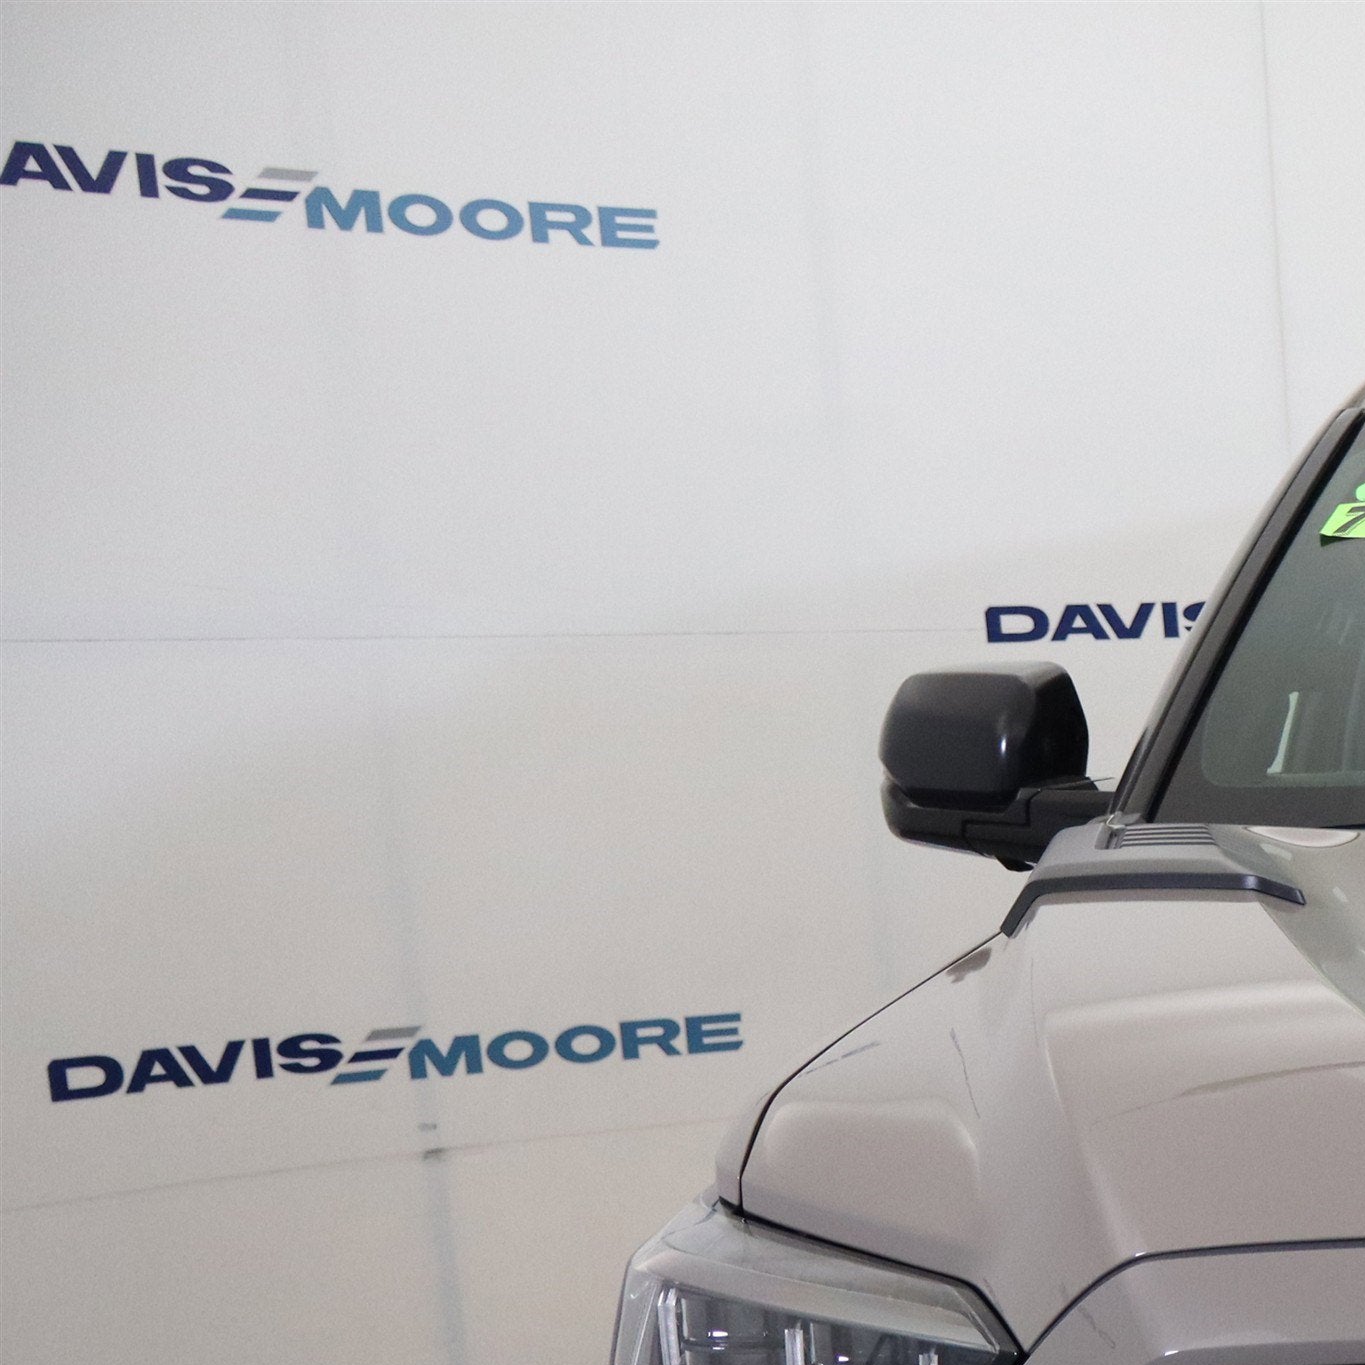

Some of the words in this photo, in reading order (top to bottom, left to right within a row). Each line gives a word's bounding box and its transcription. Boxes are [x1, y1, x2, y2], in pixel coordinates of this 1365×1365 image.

[0, 140, 236, 203] AVIS
[305, 185, 661, 250] MOORE
[48, 1033, 345, 1103] DAVIS
[408, 1012, 744, 1081] MOORE
